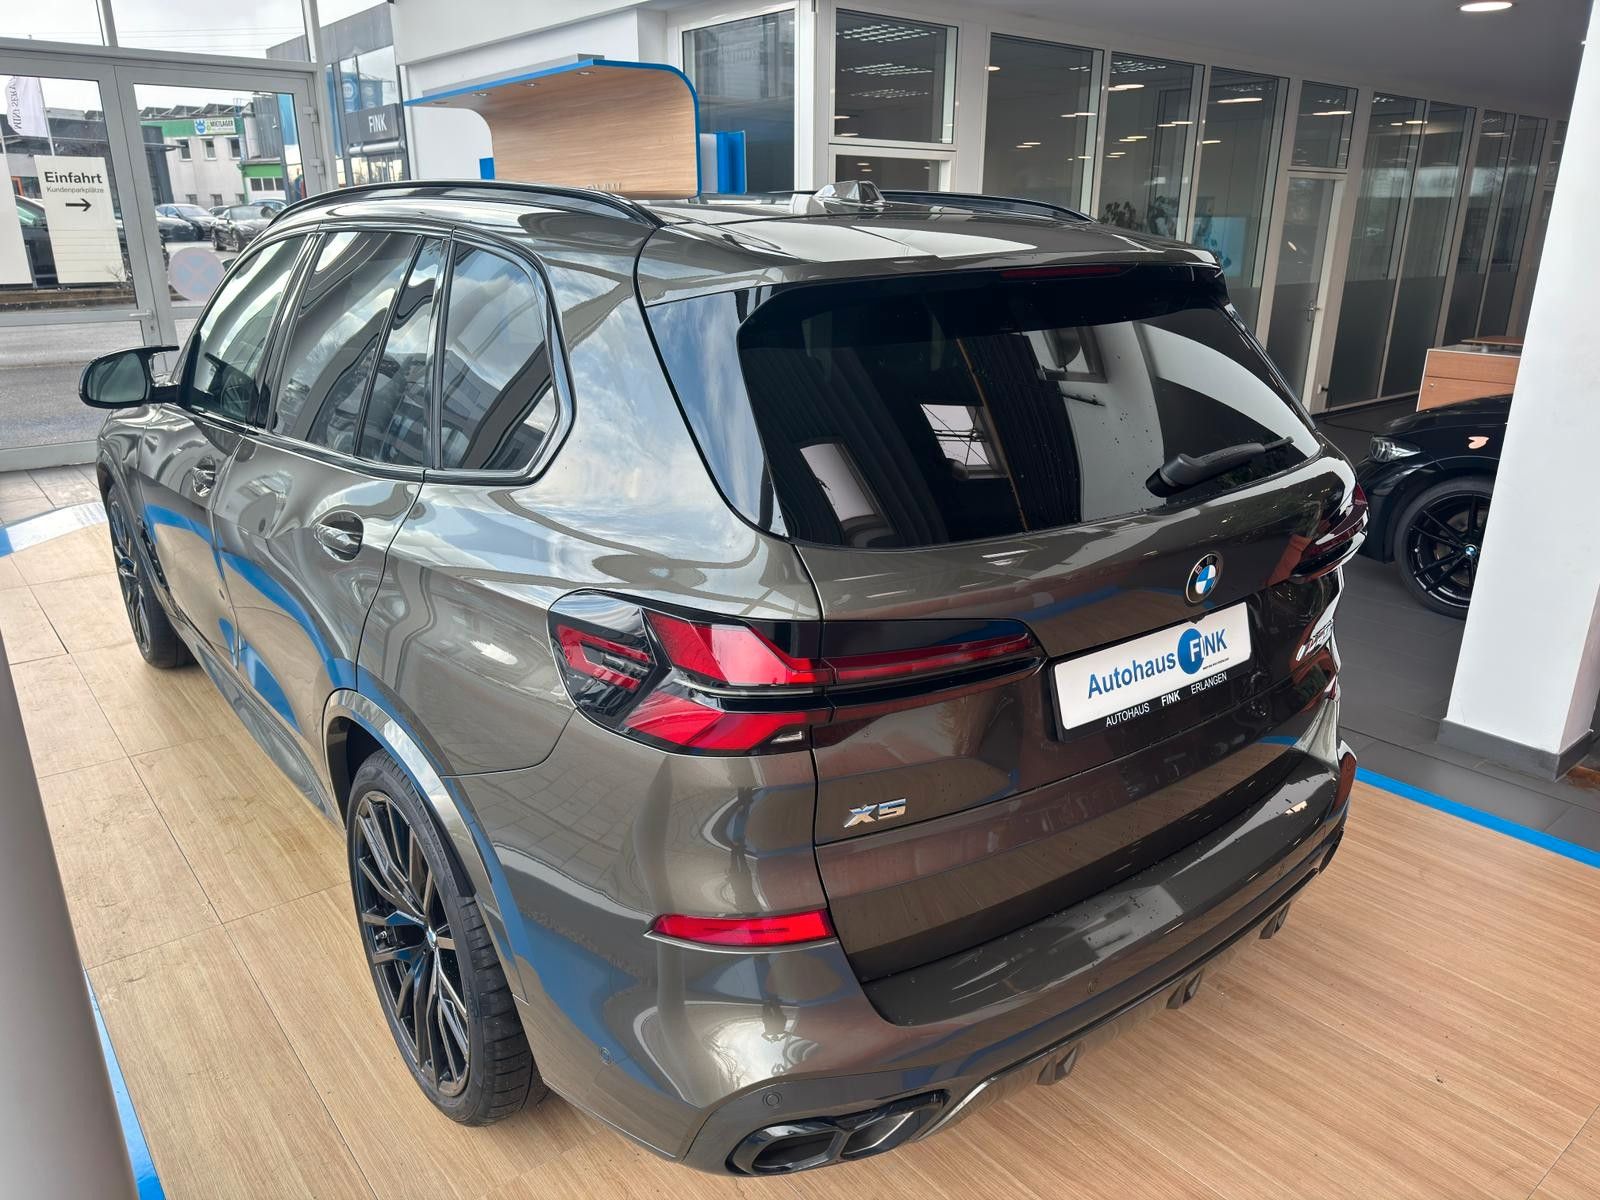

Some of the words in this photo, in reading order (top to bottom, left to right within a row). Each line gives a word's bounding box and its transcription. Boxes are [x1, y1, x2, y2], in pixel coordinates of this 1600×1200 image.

[368, 113, 388, 134] FINK
[44, 171, 103, 184] Einfahrt
[46, 186, 105, 194] Kundenparkplätze
[1087, 652, 1176, 699] Autohaus
[1189, 628, 1228, 662] FINK
[1105, 702, 1150, 728] AUTOHAUS
[1161, 690, 1181, 707] FINK
[1190, 671, 1228, 695] ERLANGEN
[843, 798, 907, 829] X5
